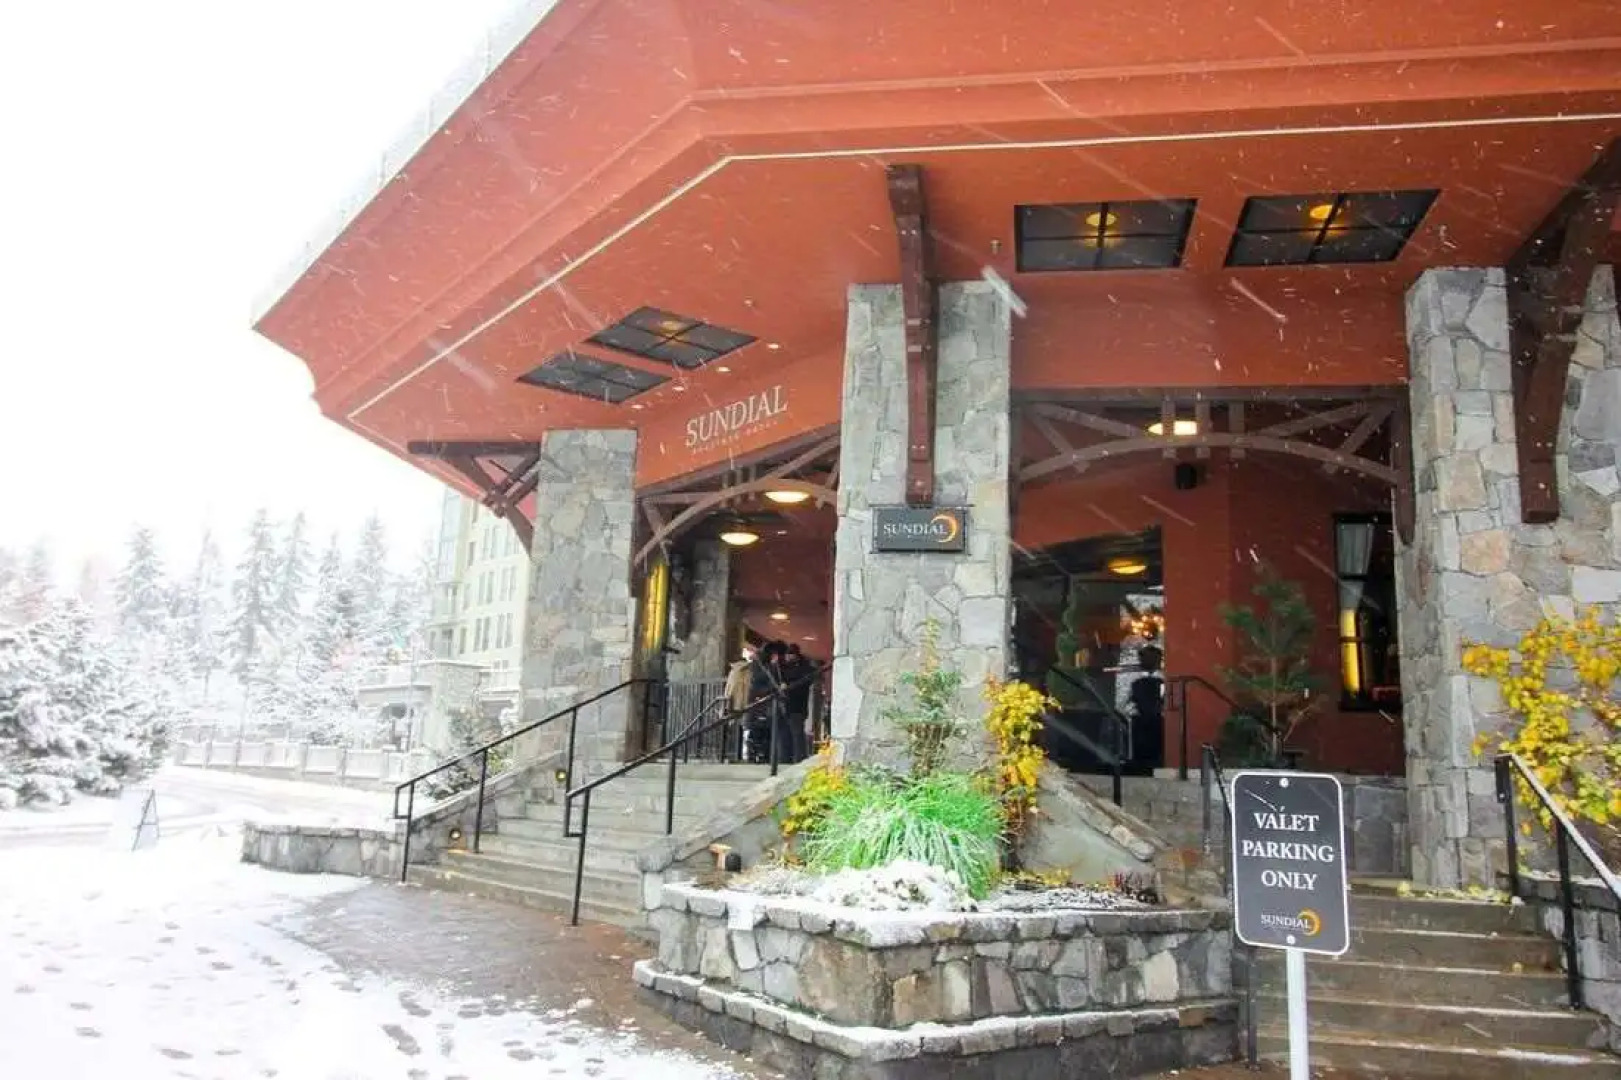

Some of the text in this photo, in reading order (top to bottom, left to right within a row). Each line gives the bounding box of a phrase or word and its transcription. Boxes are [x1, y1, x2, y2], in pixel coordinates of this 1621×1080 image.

[685, 385, 788, 447] SUNDIAL
[883, 523, 948, 535] SUNDIAL
[1253, 812, 1320, 832] VALET
[1241, 839, 1334, 863] PARKING
[1260, 870, 1318, 891] ONLY
[1260, 914, 1311, 930] SUNDIAL
